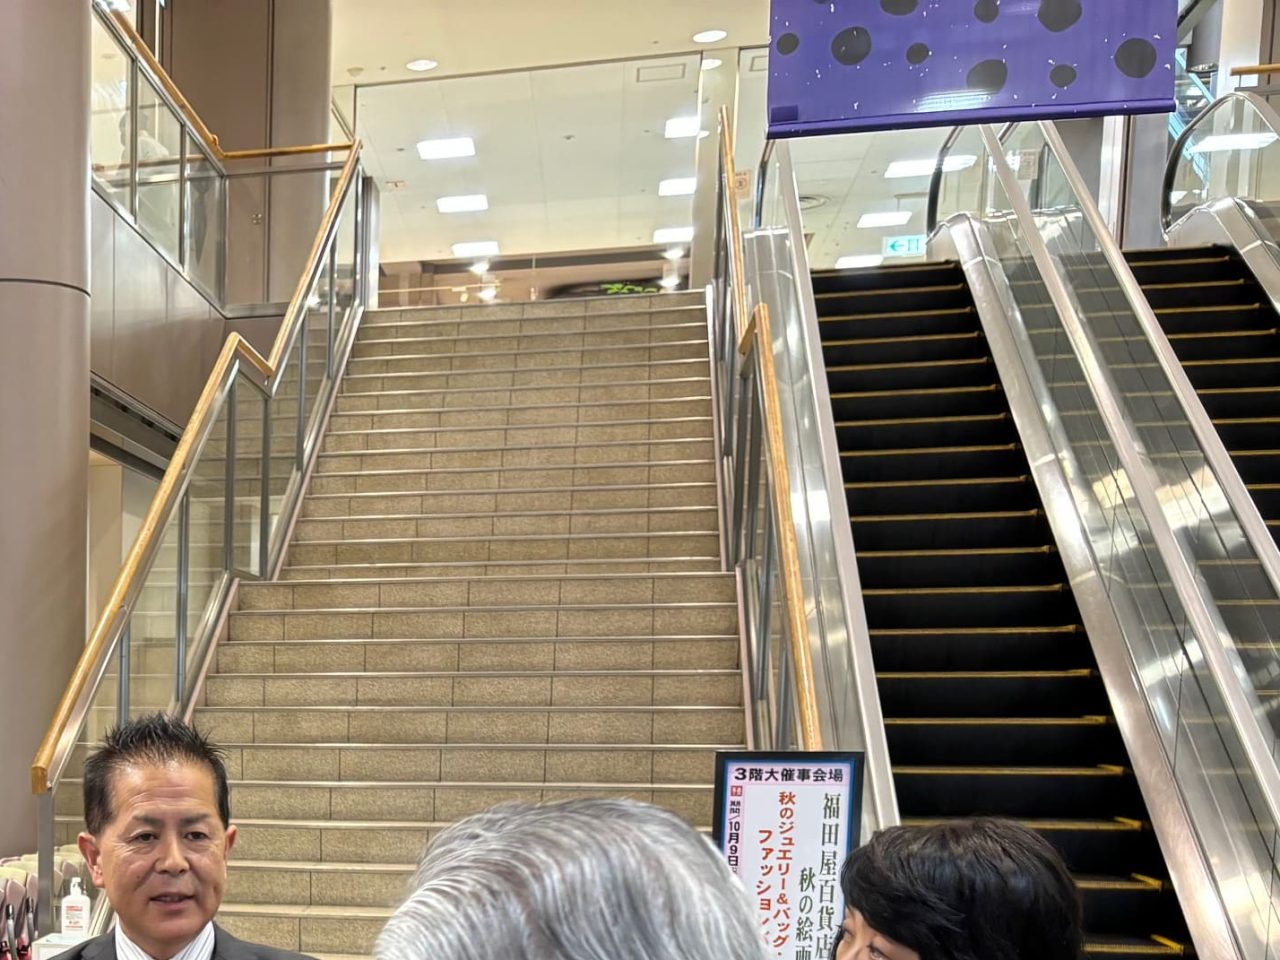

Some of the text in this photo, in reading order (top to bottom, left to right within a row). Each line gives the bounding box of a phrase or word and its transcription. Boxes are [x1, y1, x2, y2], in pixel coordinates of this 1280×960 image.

[734, 767, 844, 783] 3階大催事会場
[815, 793, 841, 959] 福田屋百貨店
